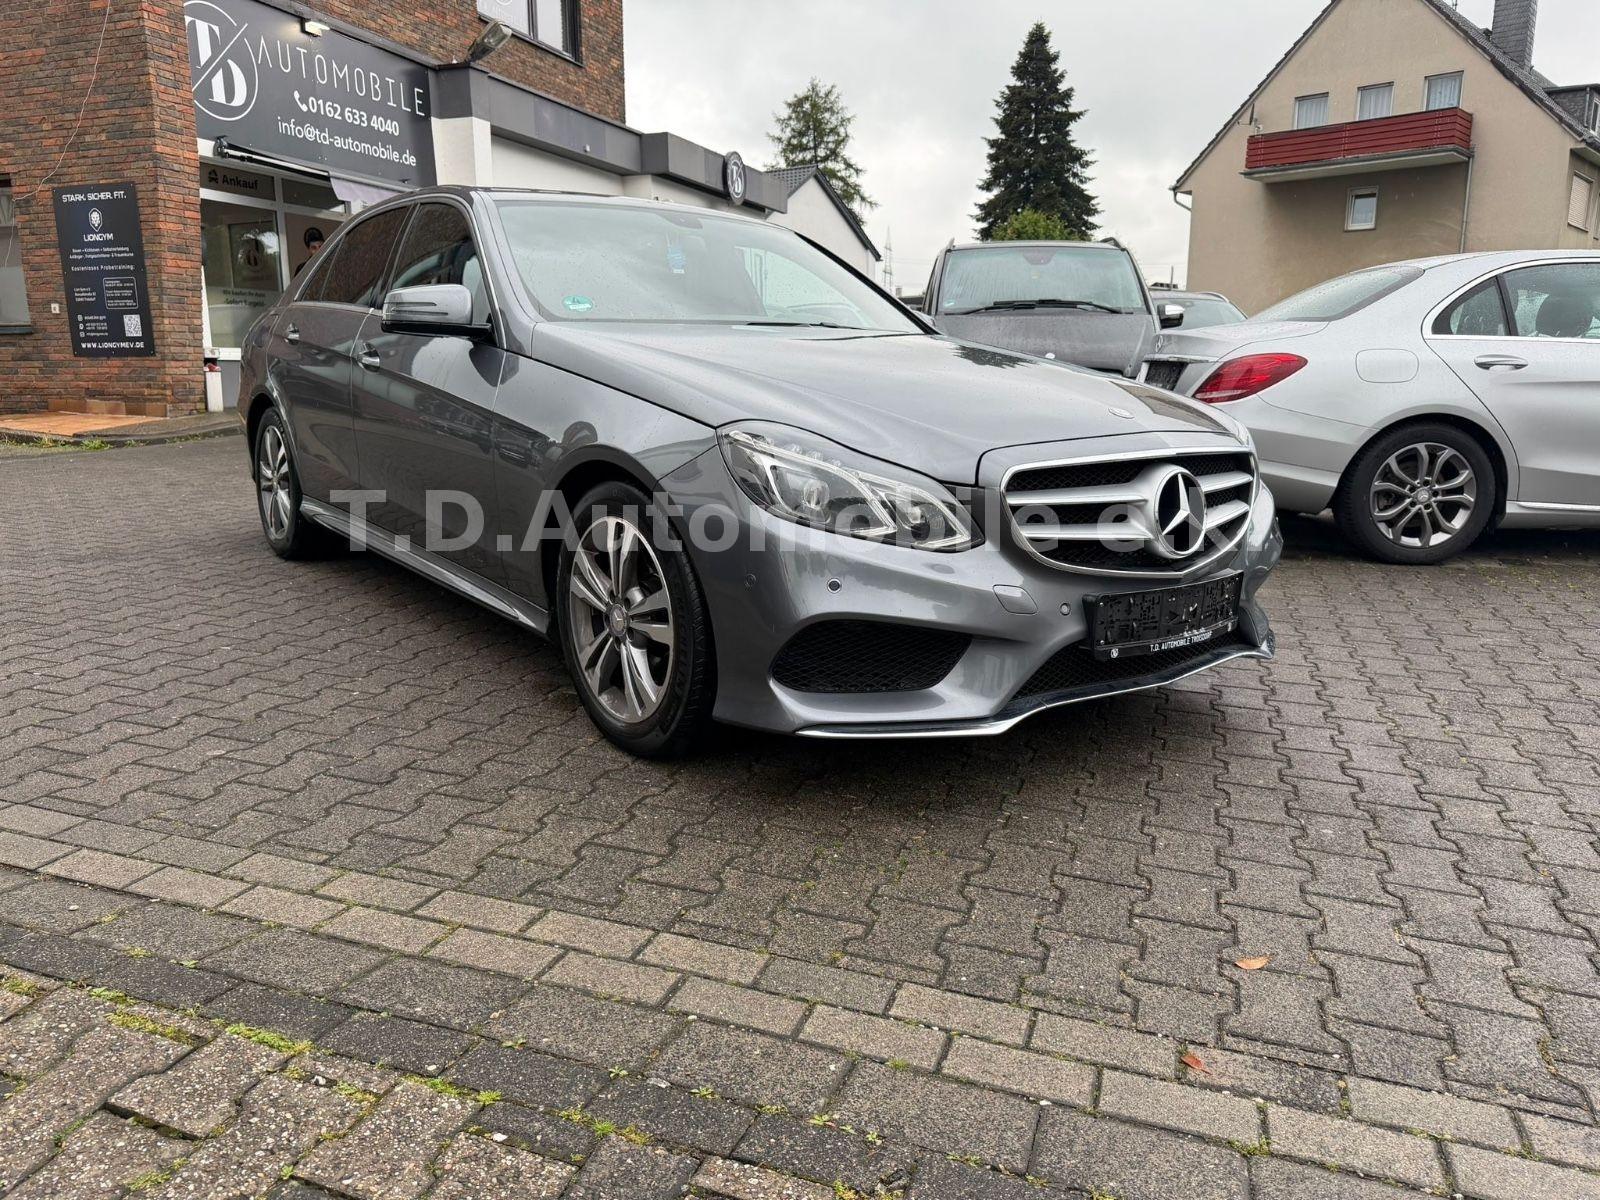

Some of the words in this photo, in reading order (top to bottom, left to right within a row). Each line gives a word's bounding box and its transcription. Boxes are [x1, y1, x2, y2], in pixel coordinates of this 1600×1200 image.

[258, 35, 425, 116] AUTOMOBILE
[309, 97, 342, 120] 0162
[345, 107, 367, 127] 633
[371, 115, 400, 136] 4040
[278, 116, 417, 167] info@td-automobile.de
[222, 174, 259, 190] Ankauf
[62, 194, 86, 203] STARK.
[113, 191, 127, 200] FIT.
[83, 233, 114, 242] LIONGYM
[1161, 637, 1191, 650] AUTOMOBILE
